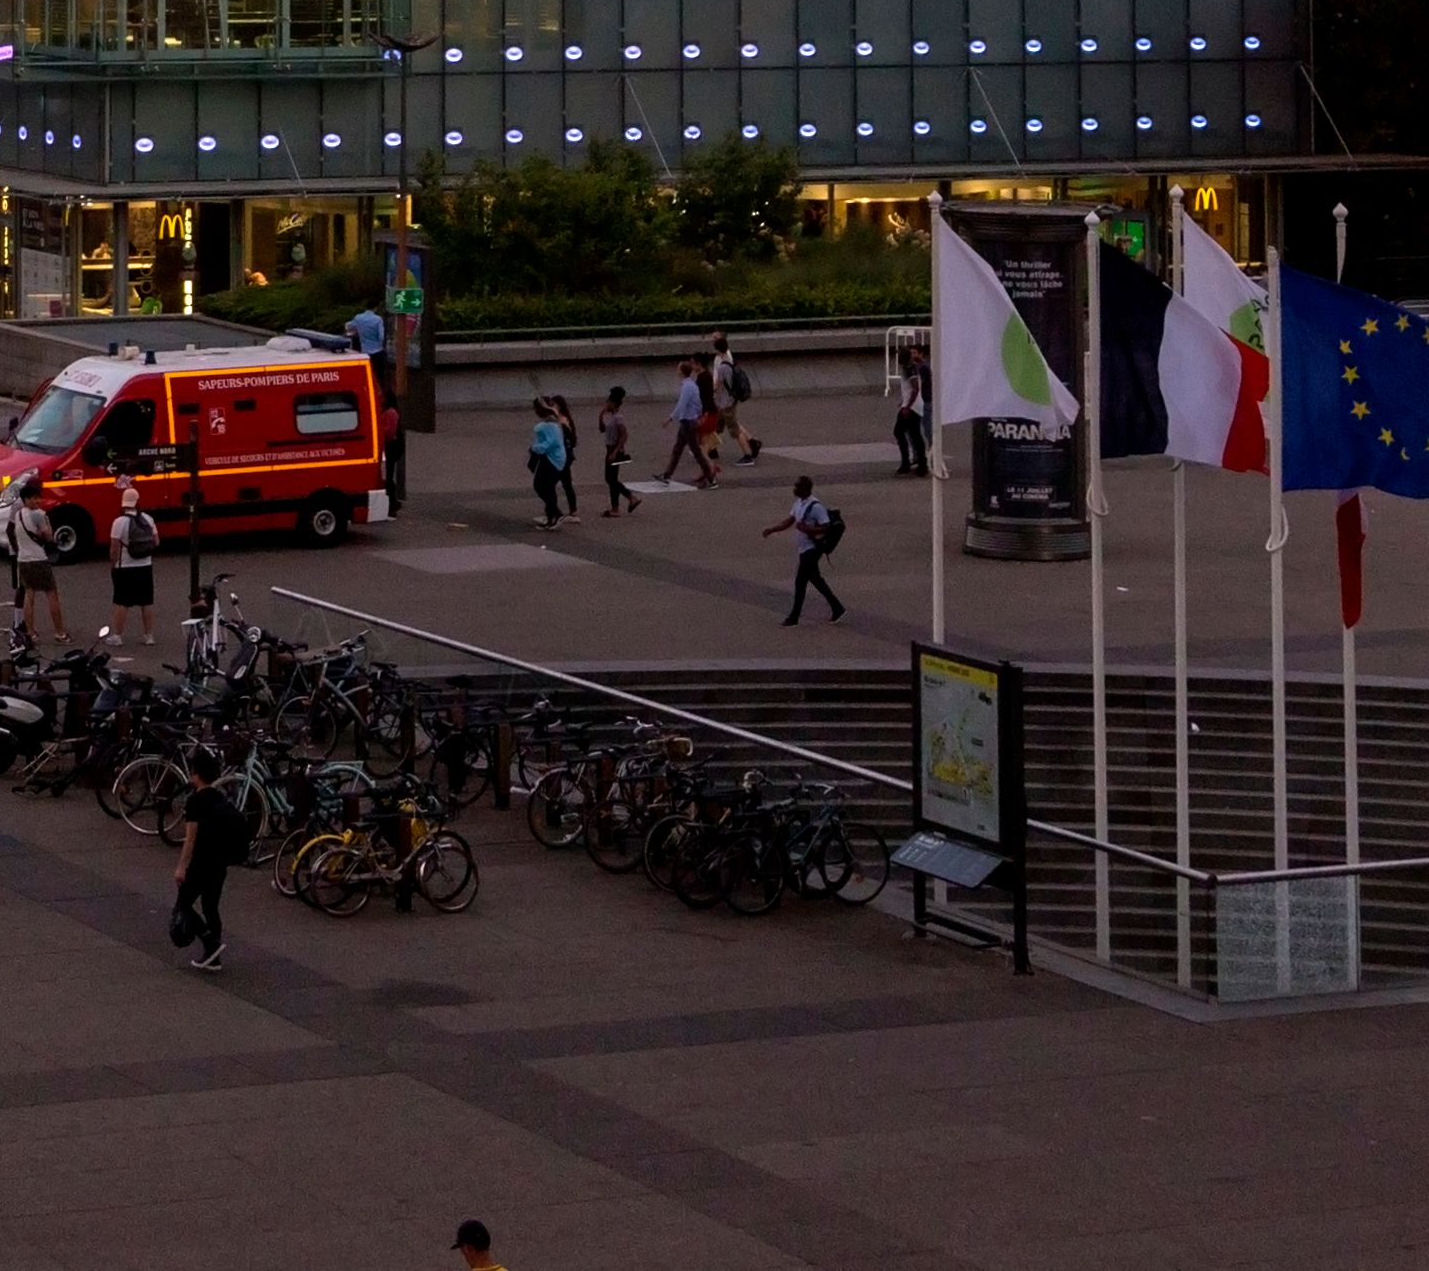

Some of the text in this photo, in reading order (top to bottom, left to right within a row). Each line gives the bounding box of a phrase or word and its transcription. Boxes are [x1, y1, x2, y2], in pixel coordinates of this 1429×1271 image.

[197, 370, 340, 391] SAPEURS-POMPIERS DE PARIS
[987, 420, 1072, 442] PARANA
